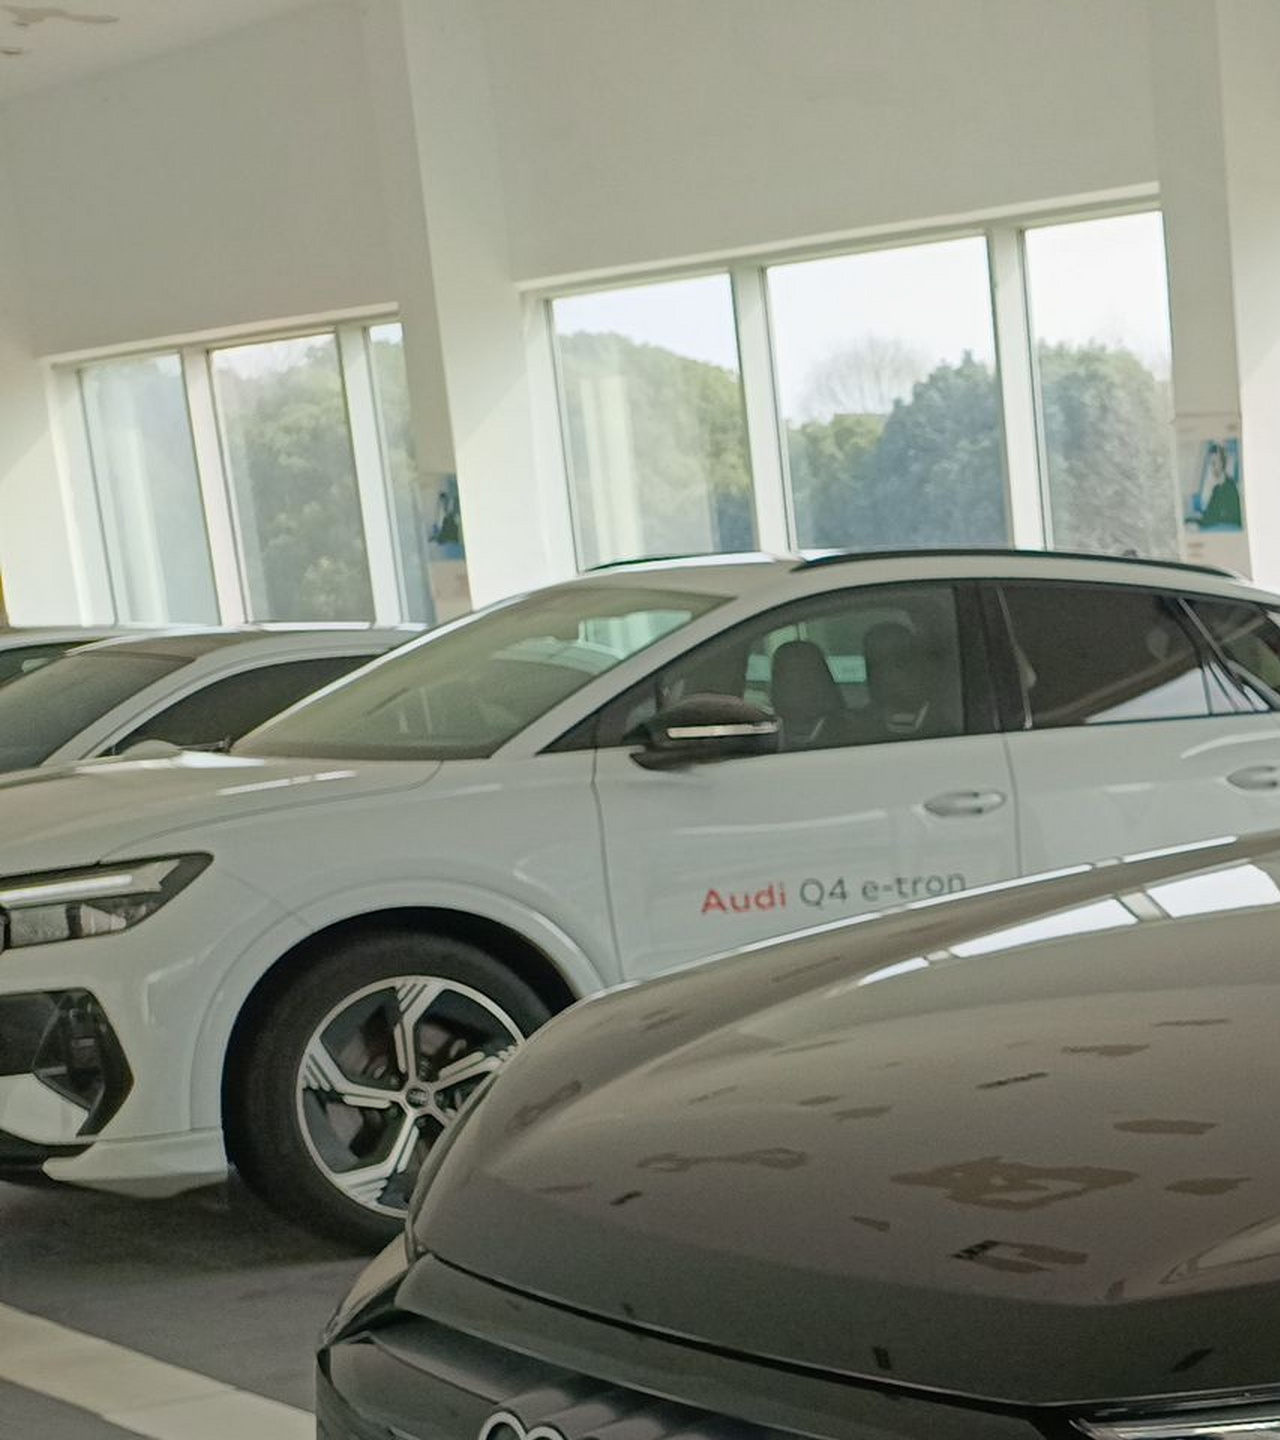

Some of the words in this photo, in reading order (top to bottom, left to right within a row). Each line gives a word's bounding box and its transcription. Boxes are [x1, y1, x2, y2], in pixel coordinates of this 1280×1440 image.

[701, 880, 787, 916] Audi
[798, 876, 849, 909] Q4
[860, 870, 967, 901] e-tron
